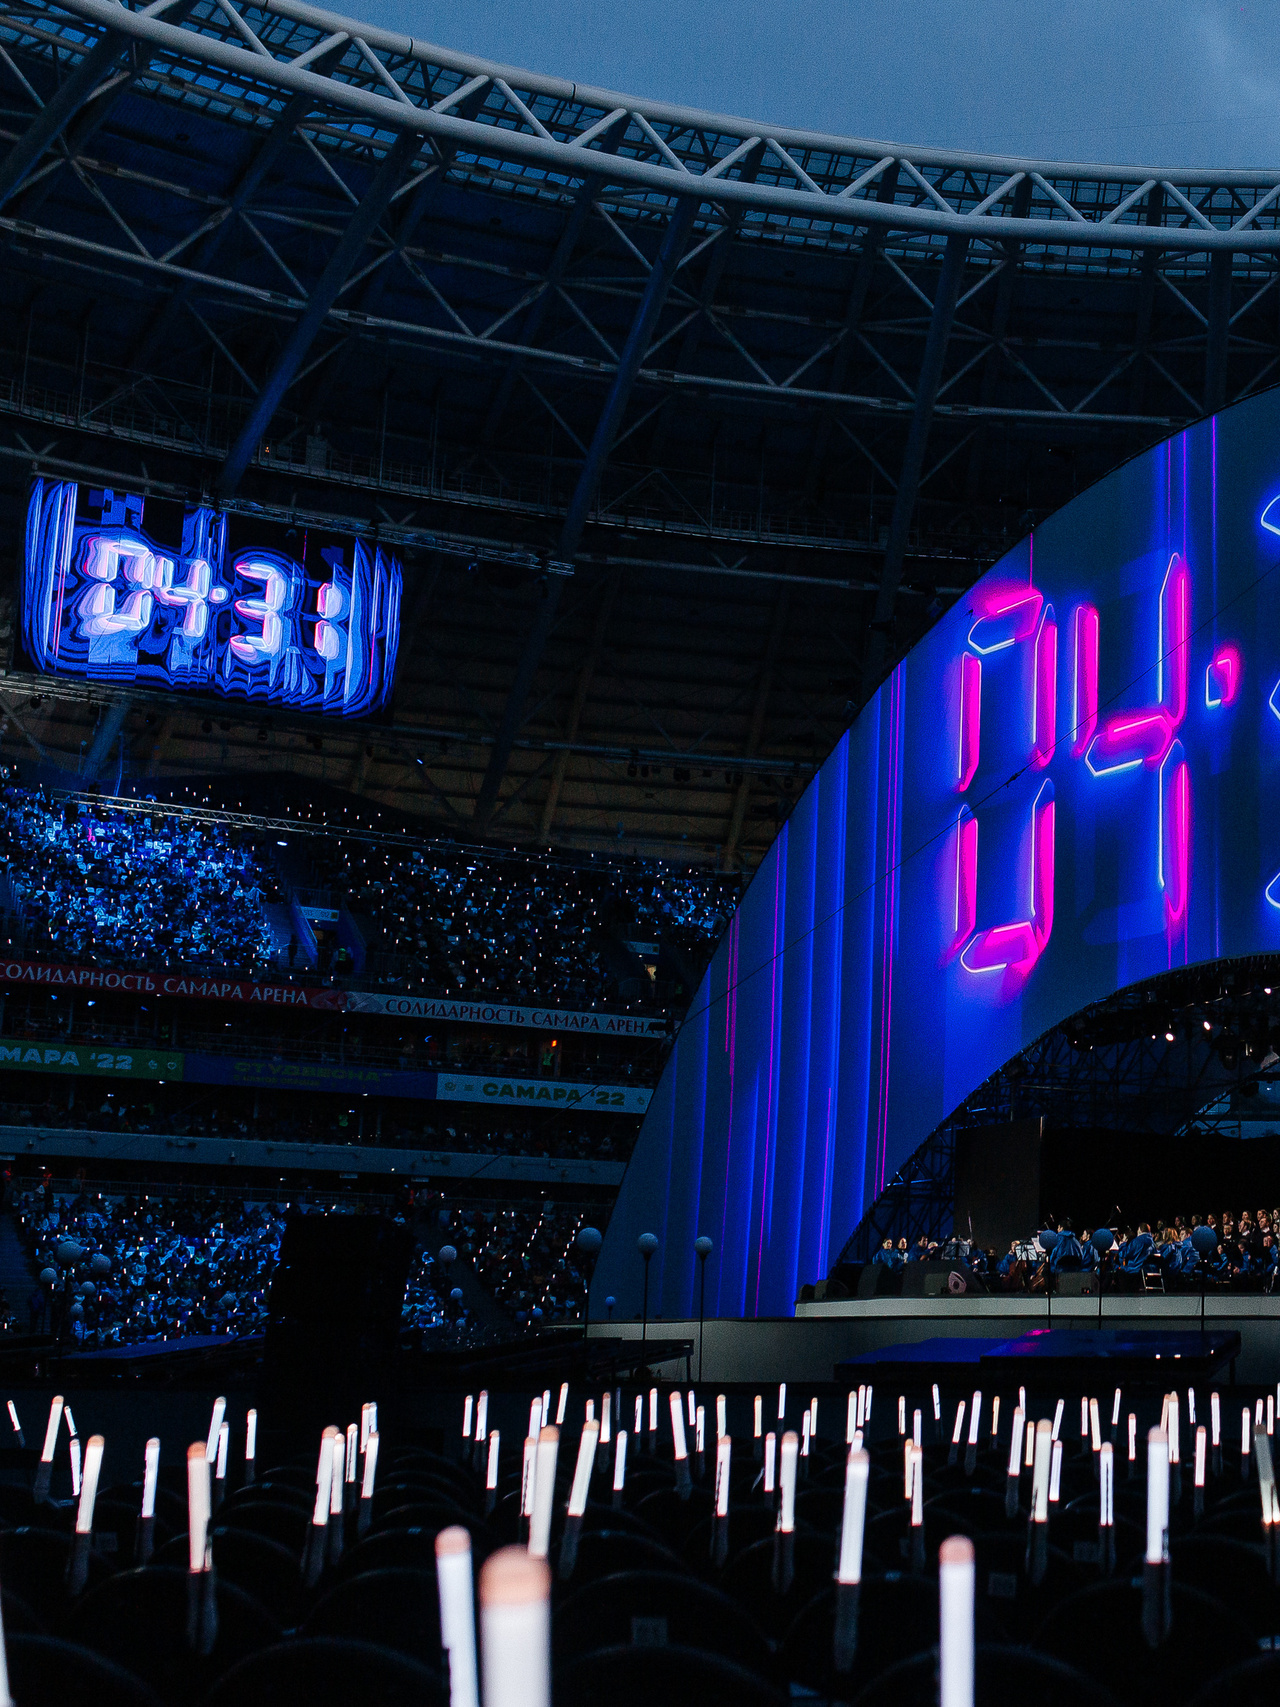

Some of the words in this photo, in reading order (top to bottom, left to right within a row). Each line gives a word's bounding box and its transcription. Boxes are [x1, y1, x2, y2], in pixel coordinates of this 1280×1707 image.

[163, 978, 243, 999] САМАРА
[249, 987, 308, 1005] АРЕНА
[385, 999, 525, 1024] СОЛИДАРНОСТЬ
[531, 1007, 600, 1031] САМАРА
[482, 1082, 581, 1103] САМАРА
